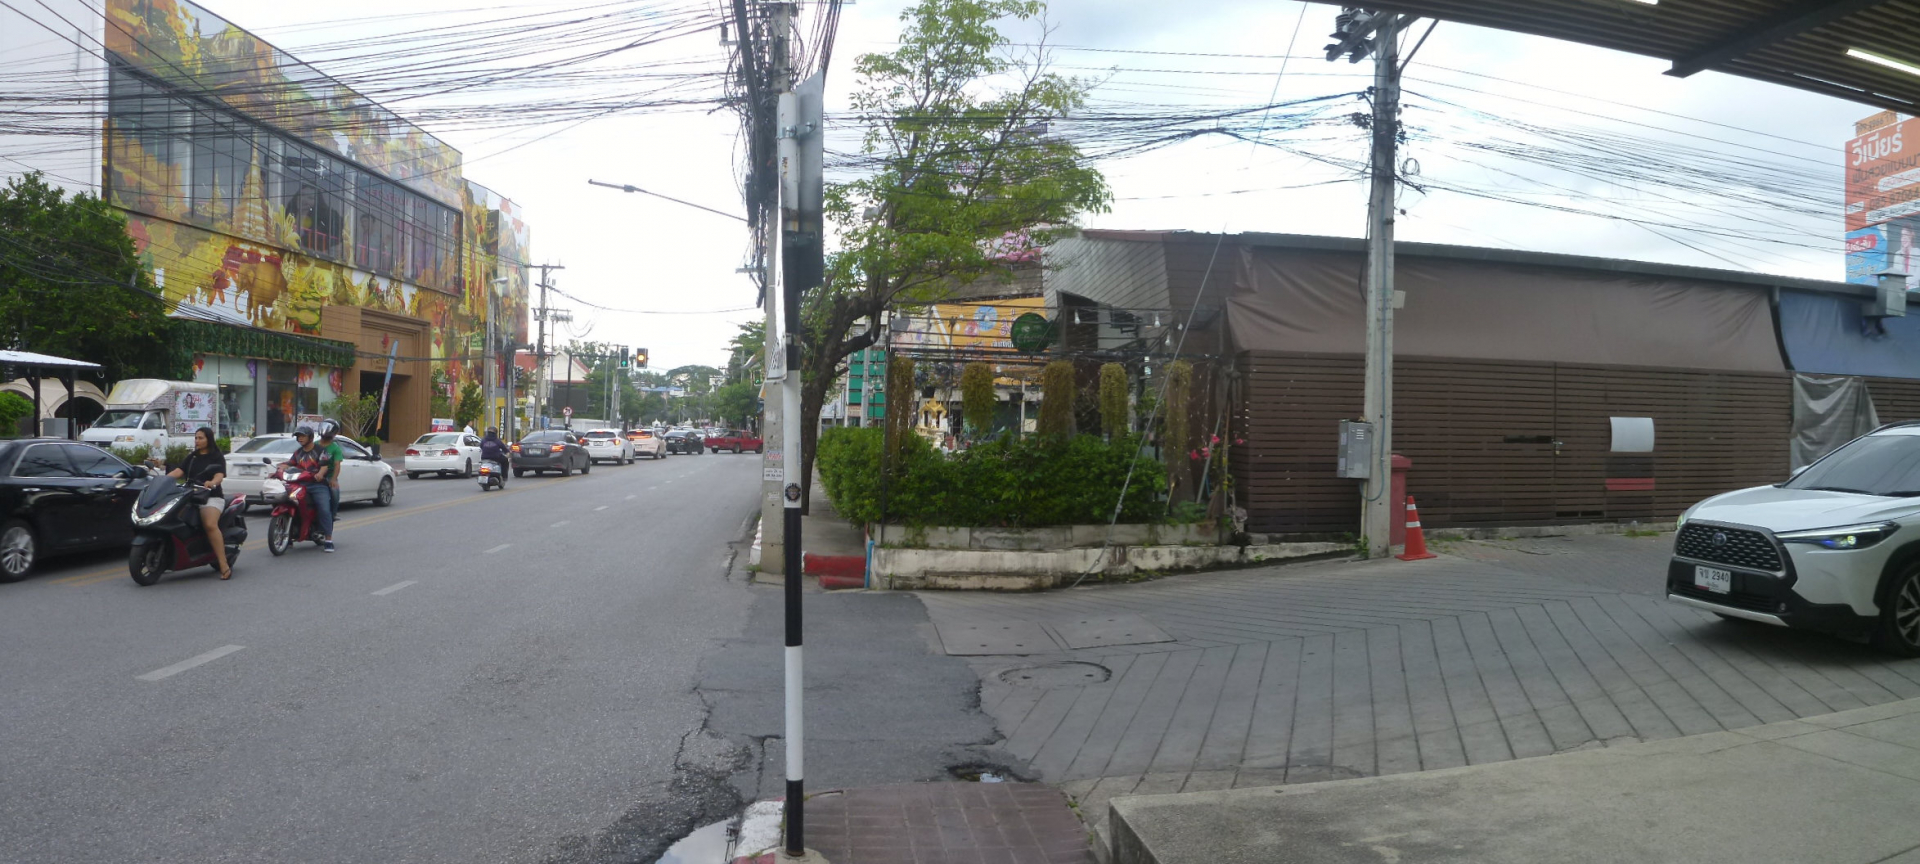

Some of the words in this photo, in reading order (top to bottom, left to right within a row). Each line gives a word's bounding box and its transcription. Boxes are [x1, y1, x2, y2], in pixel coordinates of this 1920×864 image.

[1852, 124, 1903, 166] วีเนียร์
[1712, 570, 1729, 582] 2940
